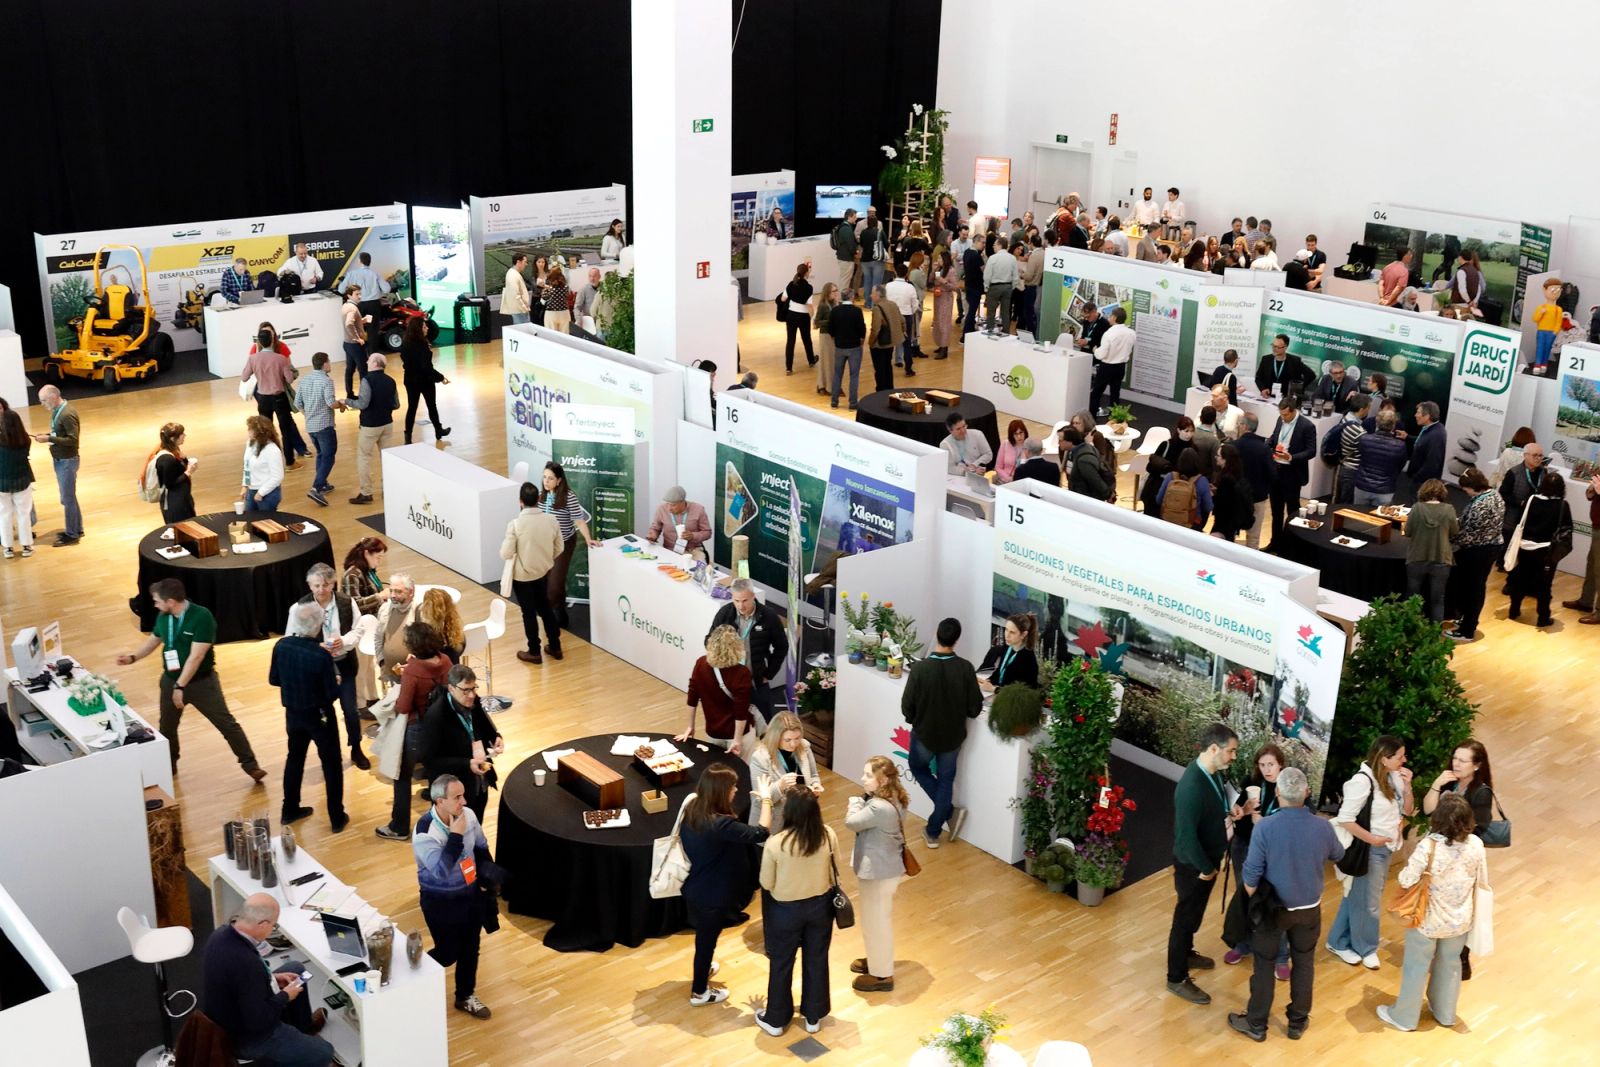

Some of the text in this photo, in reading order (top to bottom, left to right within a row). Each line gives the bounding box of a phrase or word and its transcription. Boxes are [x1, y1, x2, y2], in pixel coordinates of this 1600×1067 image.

[488, 203, 501, 213] 10
[1373, 210, 1387, 221] 04
[251, 222, 265, 234] 27
[60, 239, 76, 251] 27
[201, 245, 235, 258] XZ8
[1052, 257, 1065, 269] 23
[1268, 298, 1284, 313] 22
[509, 338, 519, 353] 17
[1329, 333, 1341, 341] con
[1340, 334, 1364, 347] biochar
[1470, 341, 1510, 364] BRUC
[1569, 356, 1585, 371] 21
[1465, 360, 1506, 383] JARDÍ
[726, 405, 739, 423] 16
[560, 455, 597, 467] ynject
[759, 471, 791, 491] ynject
[1008, 504, 1025, 525] 15
[1003, 540, 1273, 644] SOLUCIONES VEGETALES PARA ESPACIOS URBANOS
[1083, 585, 1101, 596] gama
[1101, 589, 1110, 599] de
[1142, 603, 1188, 627] Programación
[1188, 621, 1205, 633] para
[1205, 626, 1224, 640] obras
[1229, 636, 1270, 656] suministros
[631, 612, 685, 651] fertinyect
